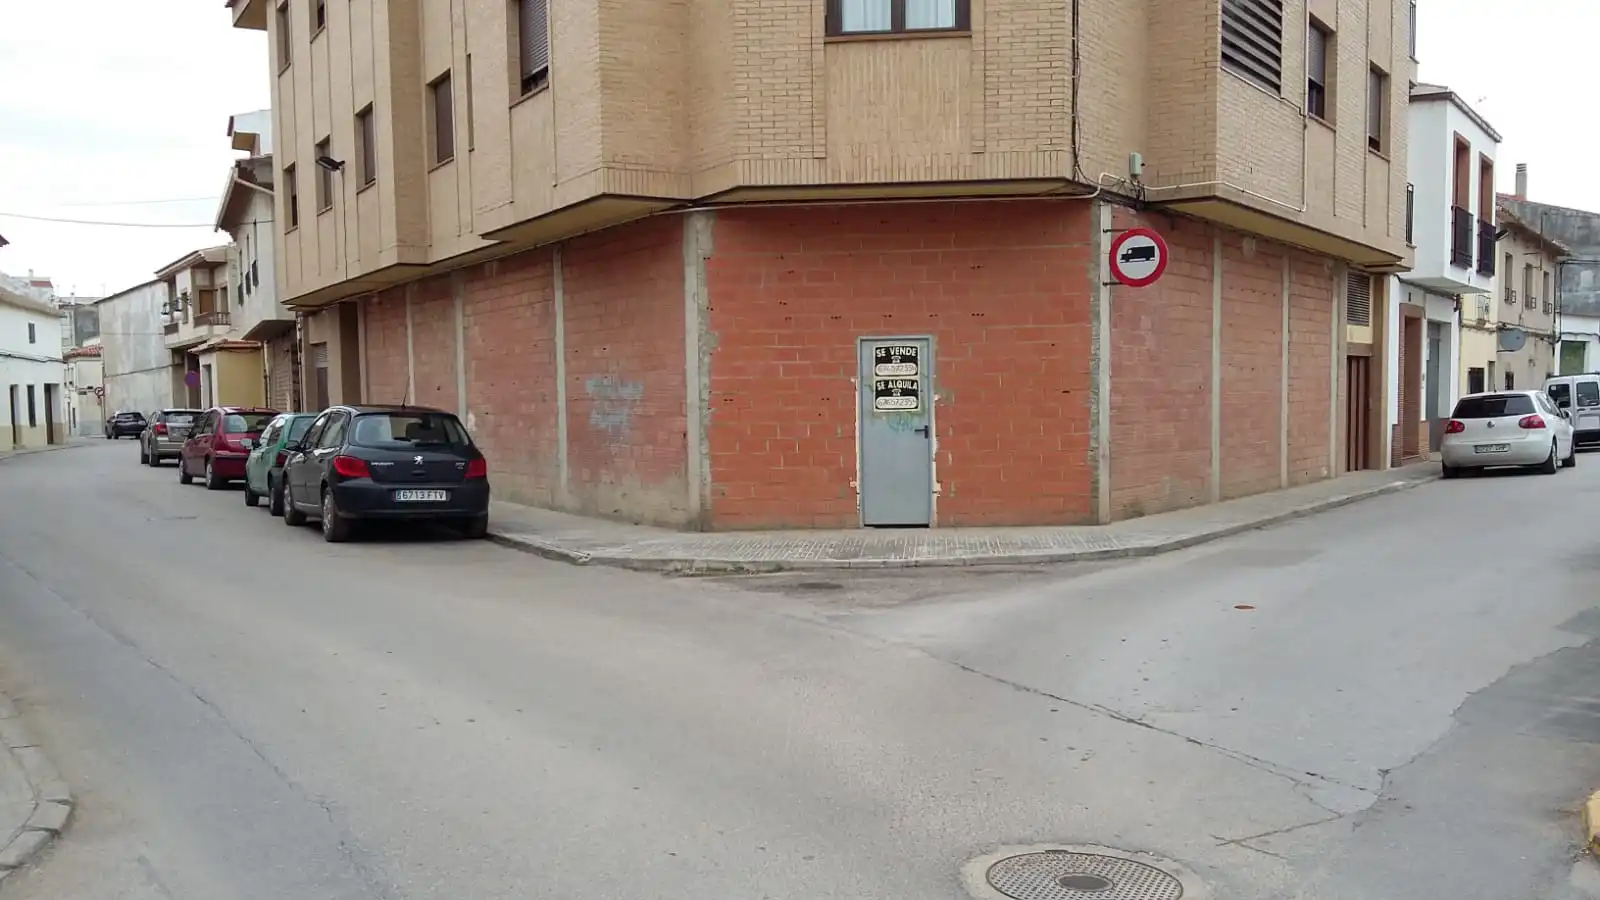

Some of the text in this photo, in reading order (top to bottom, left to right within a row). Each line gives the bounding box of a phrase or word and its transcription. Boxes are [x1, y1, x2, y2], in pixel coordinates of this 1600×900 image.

[876, 347, 917, 357] SE VENDE
[877, 381, 917, 390] SE ALQUILA
[402, 490, 445, 500] 6713 FTV
